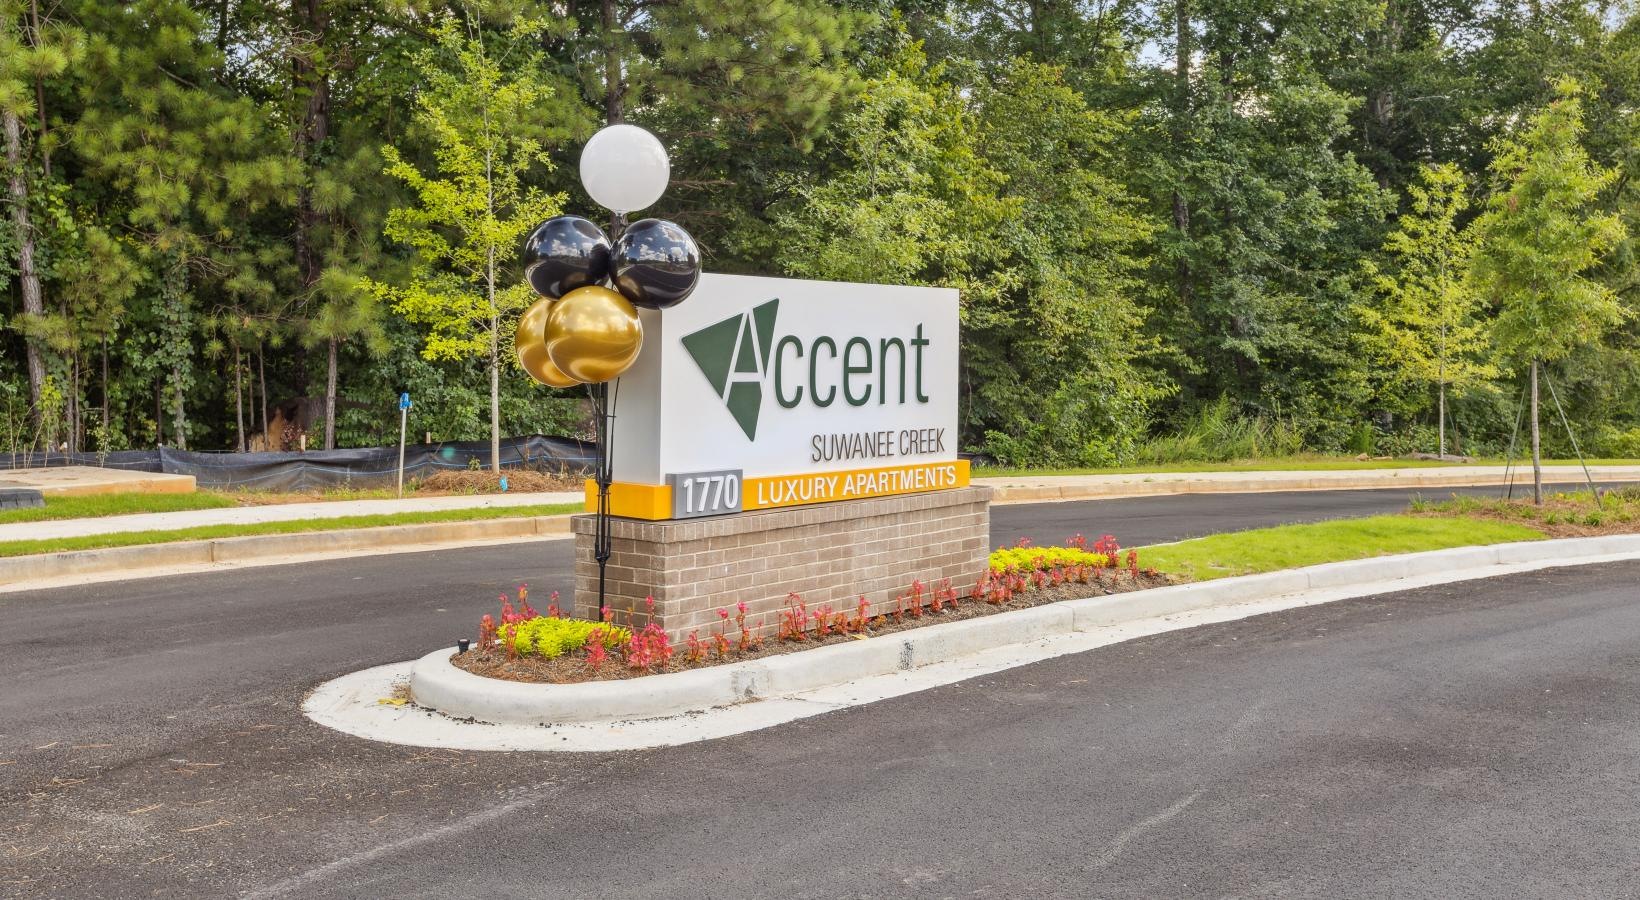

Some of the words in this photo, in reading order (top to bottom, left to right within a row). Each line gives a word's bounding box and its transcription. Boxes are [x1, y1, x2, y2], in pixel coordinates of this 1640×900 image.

[722, 308, 930, 409] Accent
[811, 430, 895, 462] SUWANEE
[899, 428, 945, 456] CREEK
[682, 474, 739, 513] 1770
[758, 475, 838, 505] LUXURY
[843, 465, 956, 496] APARTMENTS
